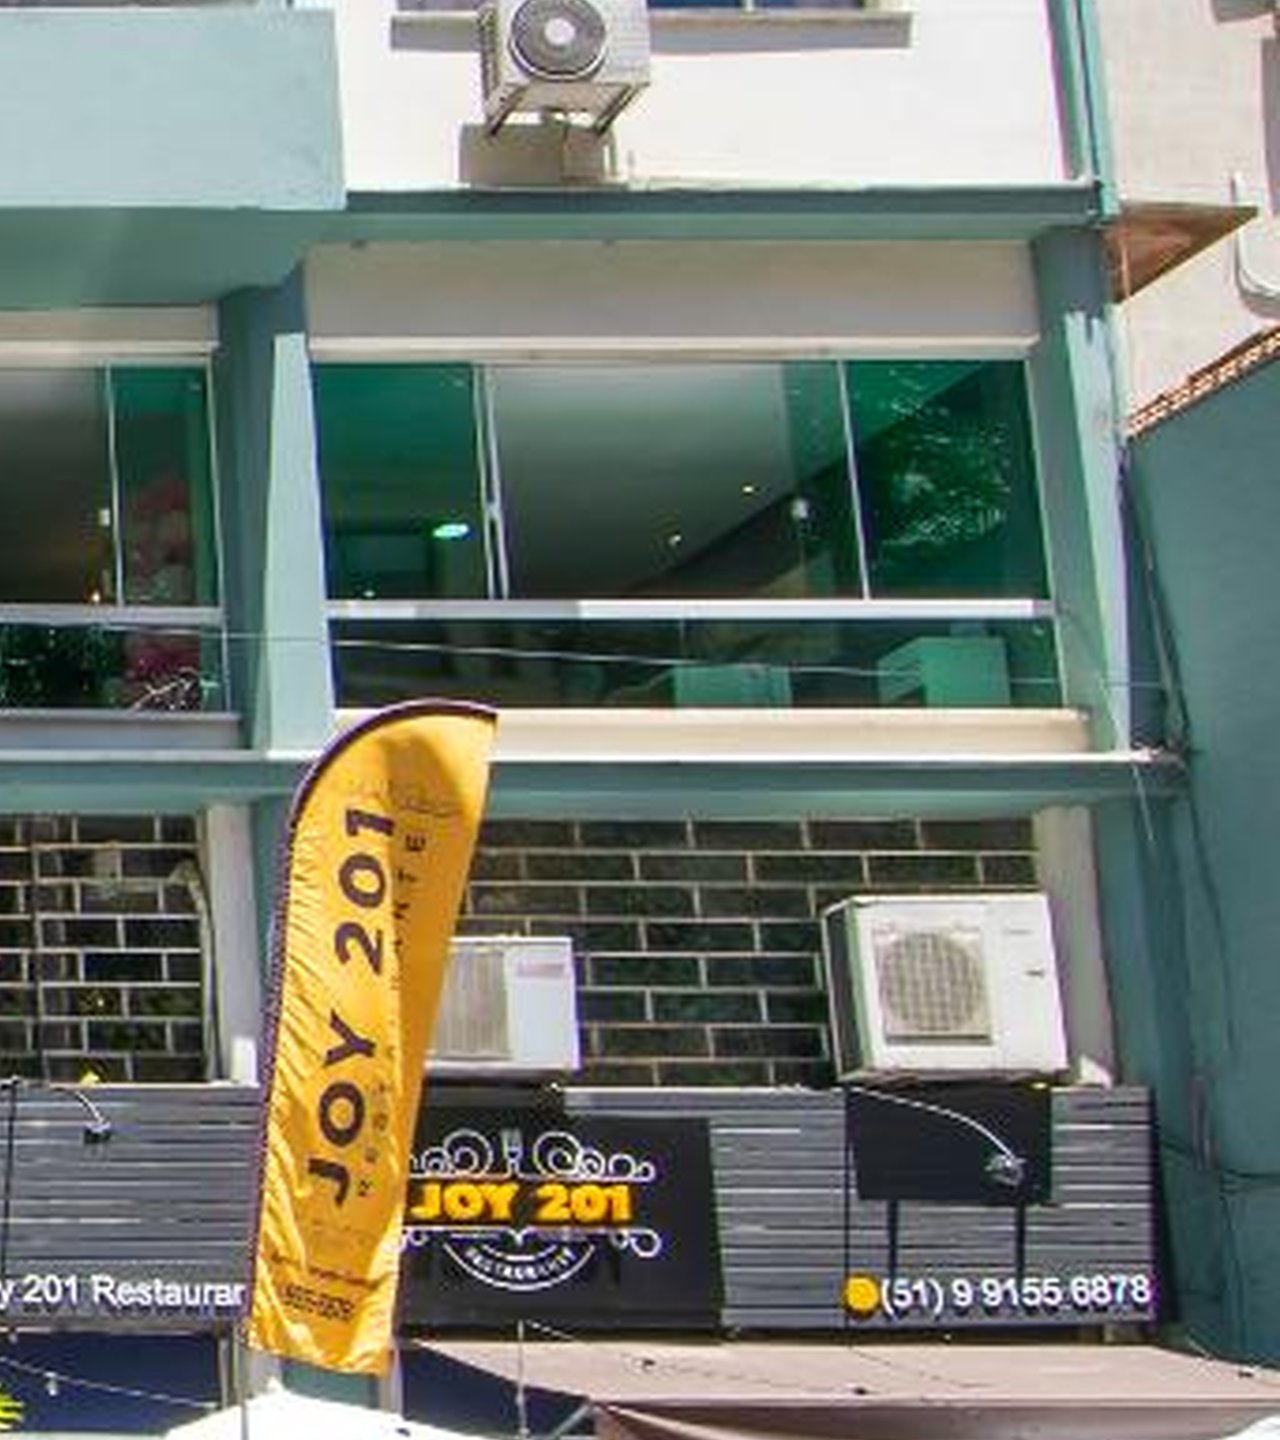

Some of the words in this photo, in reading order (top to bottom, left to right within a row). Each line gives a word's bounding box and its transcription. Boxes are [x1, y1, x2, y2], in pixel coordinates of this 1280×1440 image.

[334, 808, 398, 978] 201
[307, 1006, 378, 1207] JOY
[410, 1182, 520, 1220] JOY
[537, 1183, 631, 1221] 201
[22, 1273, 79, 1304] 201
[881, 1278, 944, 1317] (51)
[952, 1278, 974, 1306] 9
